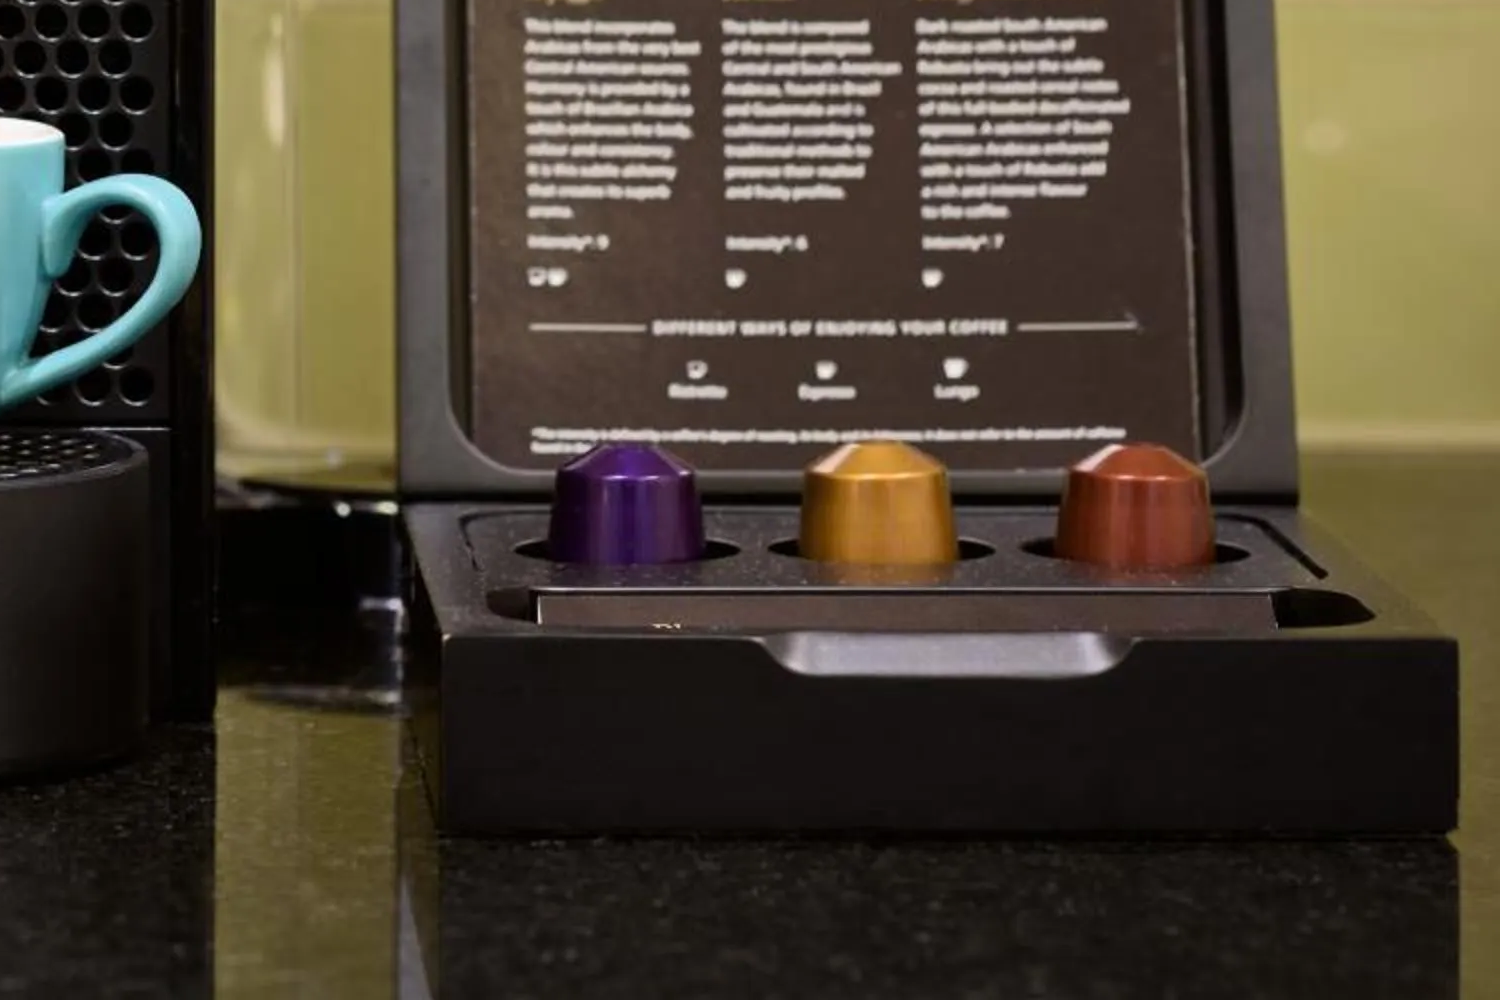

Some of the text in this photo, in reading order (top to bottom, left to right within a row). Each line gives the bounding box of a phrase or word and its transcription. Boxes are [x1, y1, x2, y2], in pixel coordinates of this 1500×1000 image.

[994, 121, 1053, 136] selection
[652, 320, 737, 336] DIFFERENT
[789, 321, 812, 336] OF
[949, 319, 1007, 335] COFFEE
